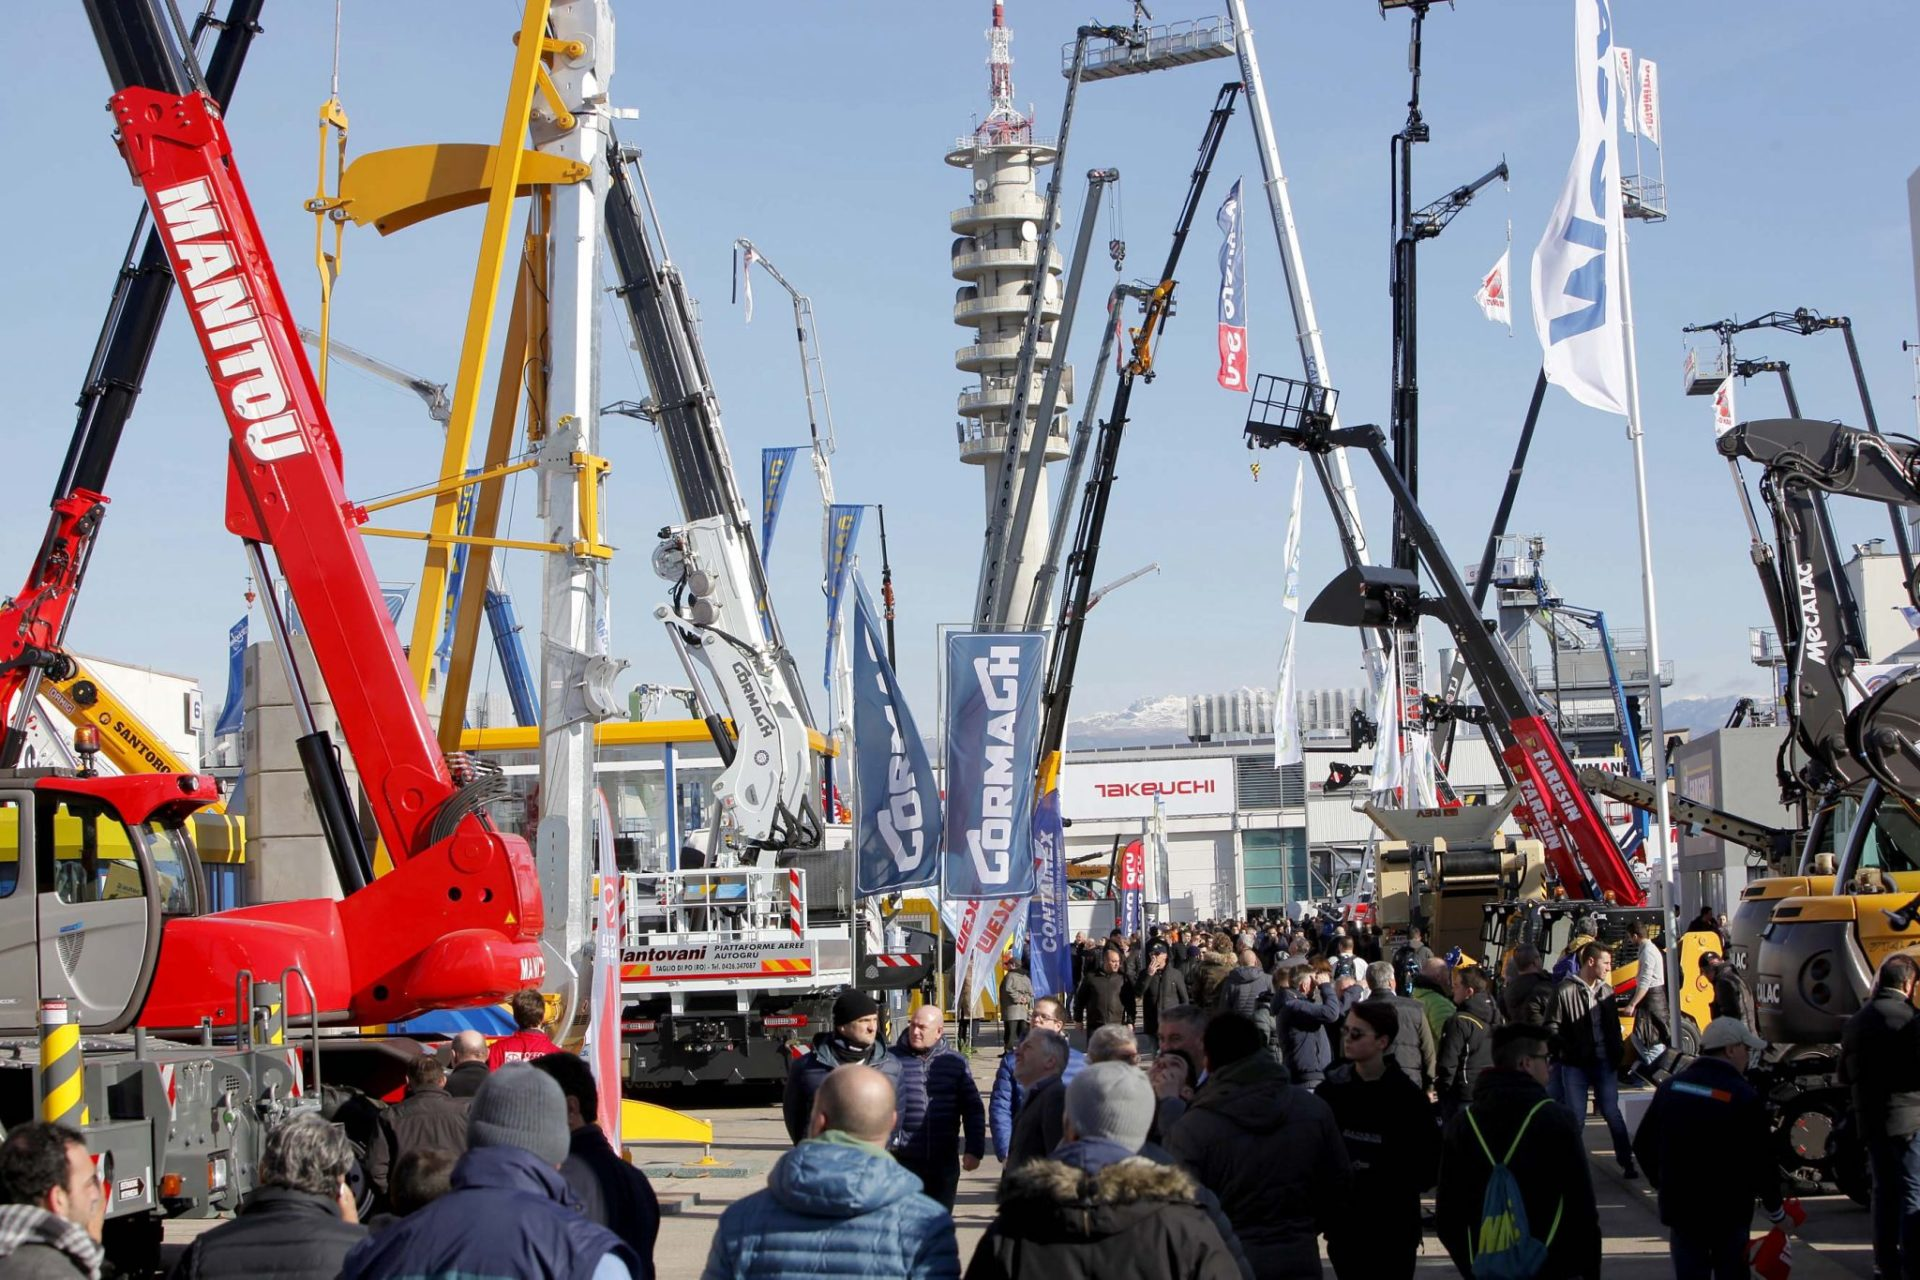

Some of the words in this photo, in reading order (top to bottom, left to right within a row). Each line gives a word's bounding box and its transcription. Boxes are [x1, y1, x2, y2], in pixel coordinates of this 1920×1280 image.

[156, 178, 309, 461] MANITOU
[50, 687, 75, 714] ORMIG
[194, 701, 201, 719] 6
[732, 661, 775, 738] CORMACH
[966, 646, 1020, 884] CORMACH
[1533, 749, 1582, 821] FARESIN
[1521, 779, 1561, 850] FARESIN
[1040, 830, 1057, 953] CONTAINEX
[714, 943, 776, 952] PIATTAFORME
[778, 942, 805, 950] AEREE
[714, 952, 759, 960] AUTOGRU
